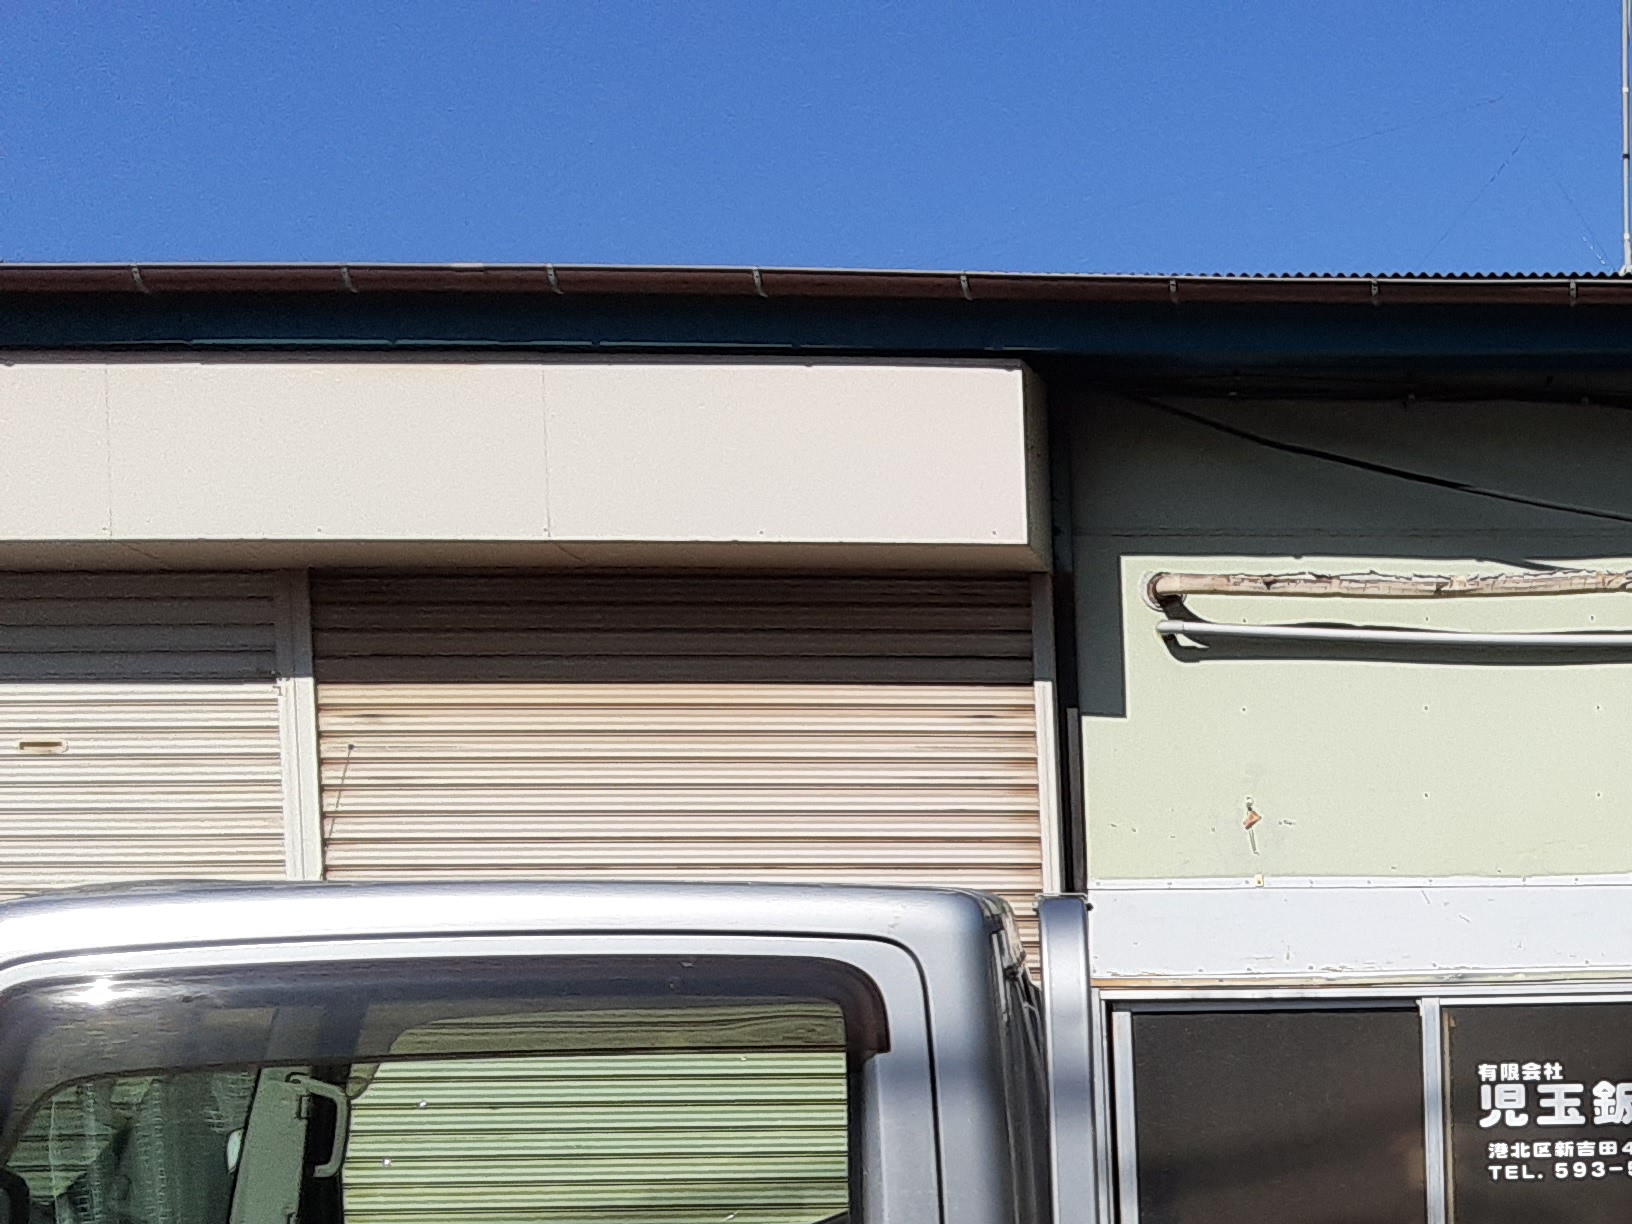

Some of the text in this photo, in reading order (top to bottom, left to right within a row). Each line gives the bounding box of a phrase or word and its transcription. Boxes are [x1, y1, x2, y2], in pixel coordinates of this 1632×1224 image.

[1478, 1063, 1564, 1081] 有限会社
[1489, 1164, 1544, 1180] TEL.
